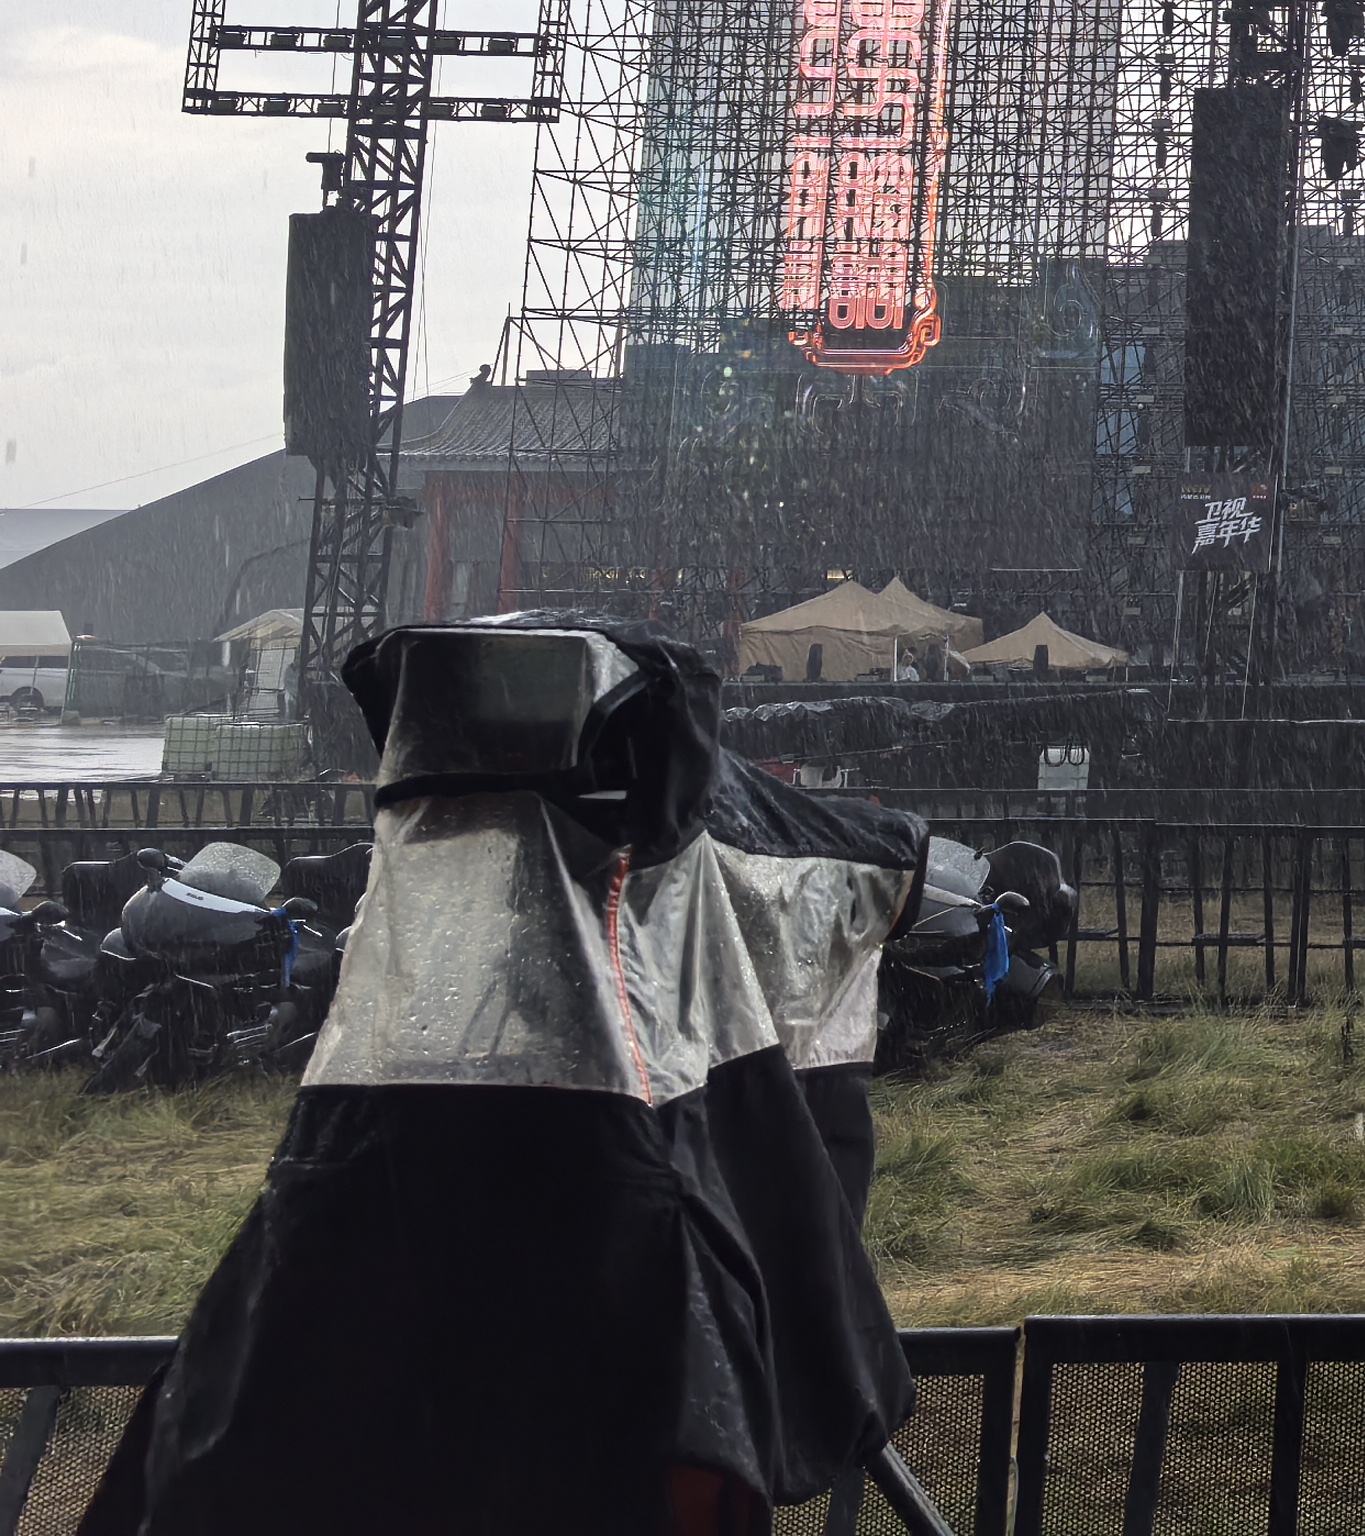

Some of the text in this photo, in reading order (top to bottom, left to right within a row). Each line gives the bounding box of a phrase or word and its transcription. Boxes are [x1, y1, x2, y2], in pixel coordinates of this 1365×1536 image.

[1194, 497, 1254, 523] 卫视
[1191, 517, 1262, 554] 嘉年华
